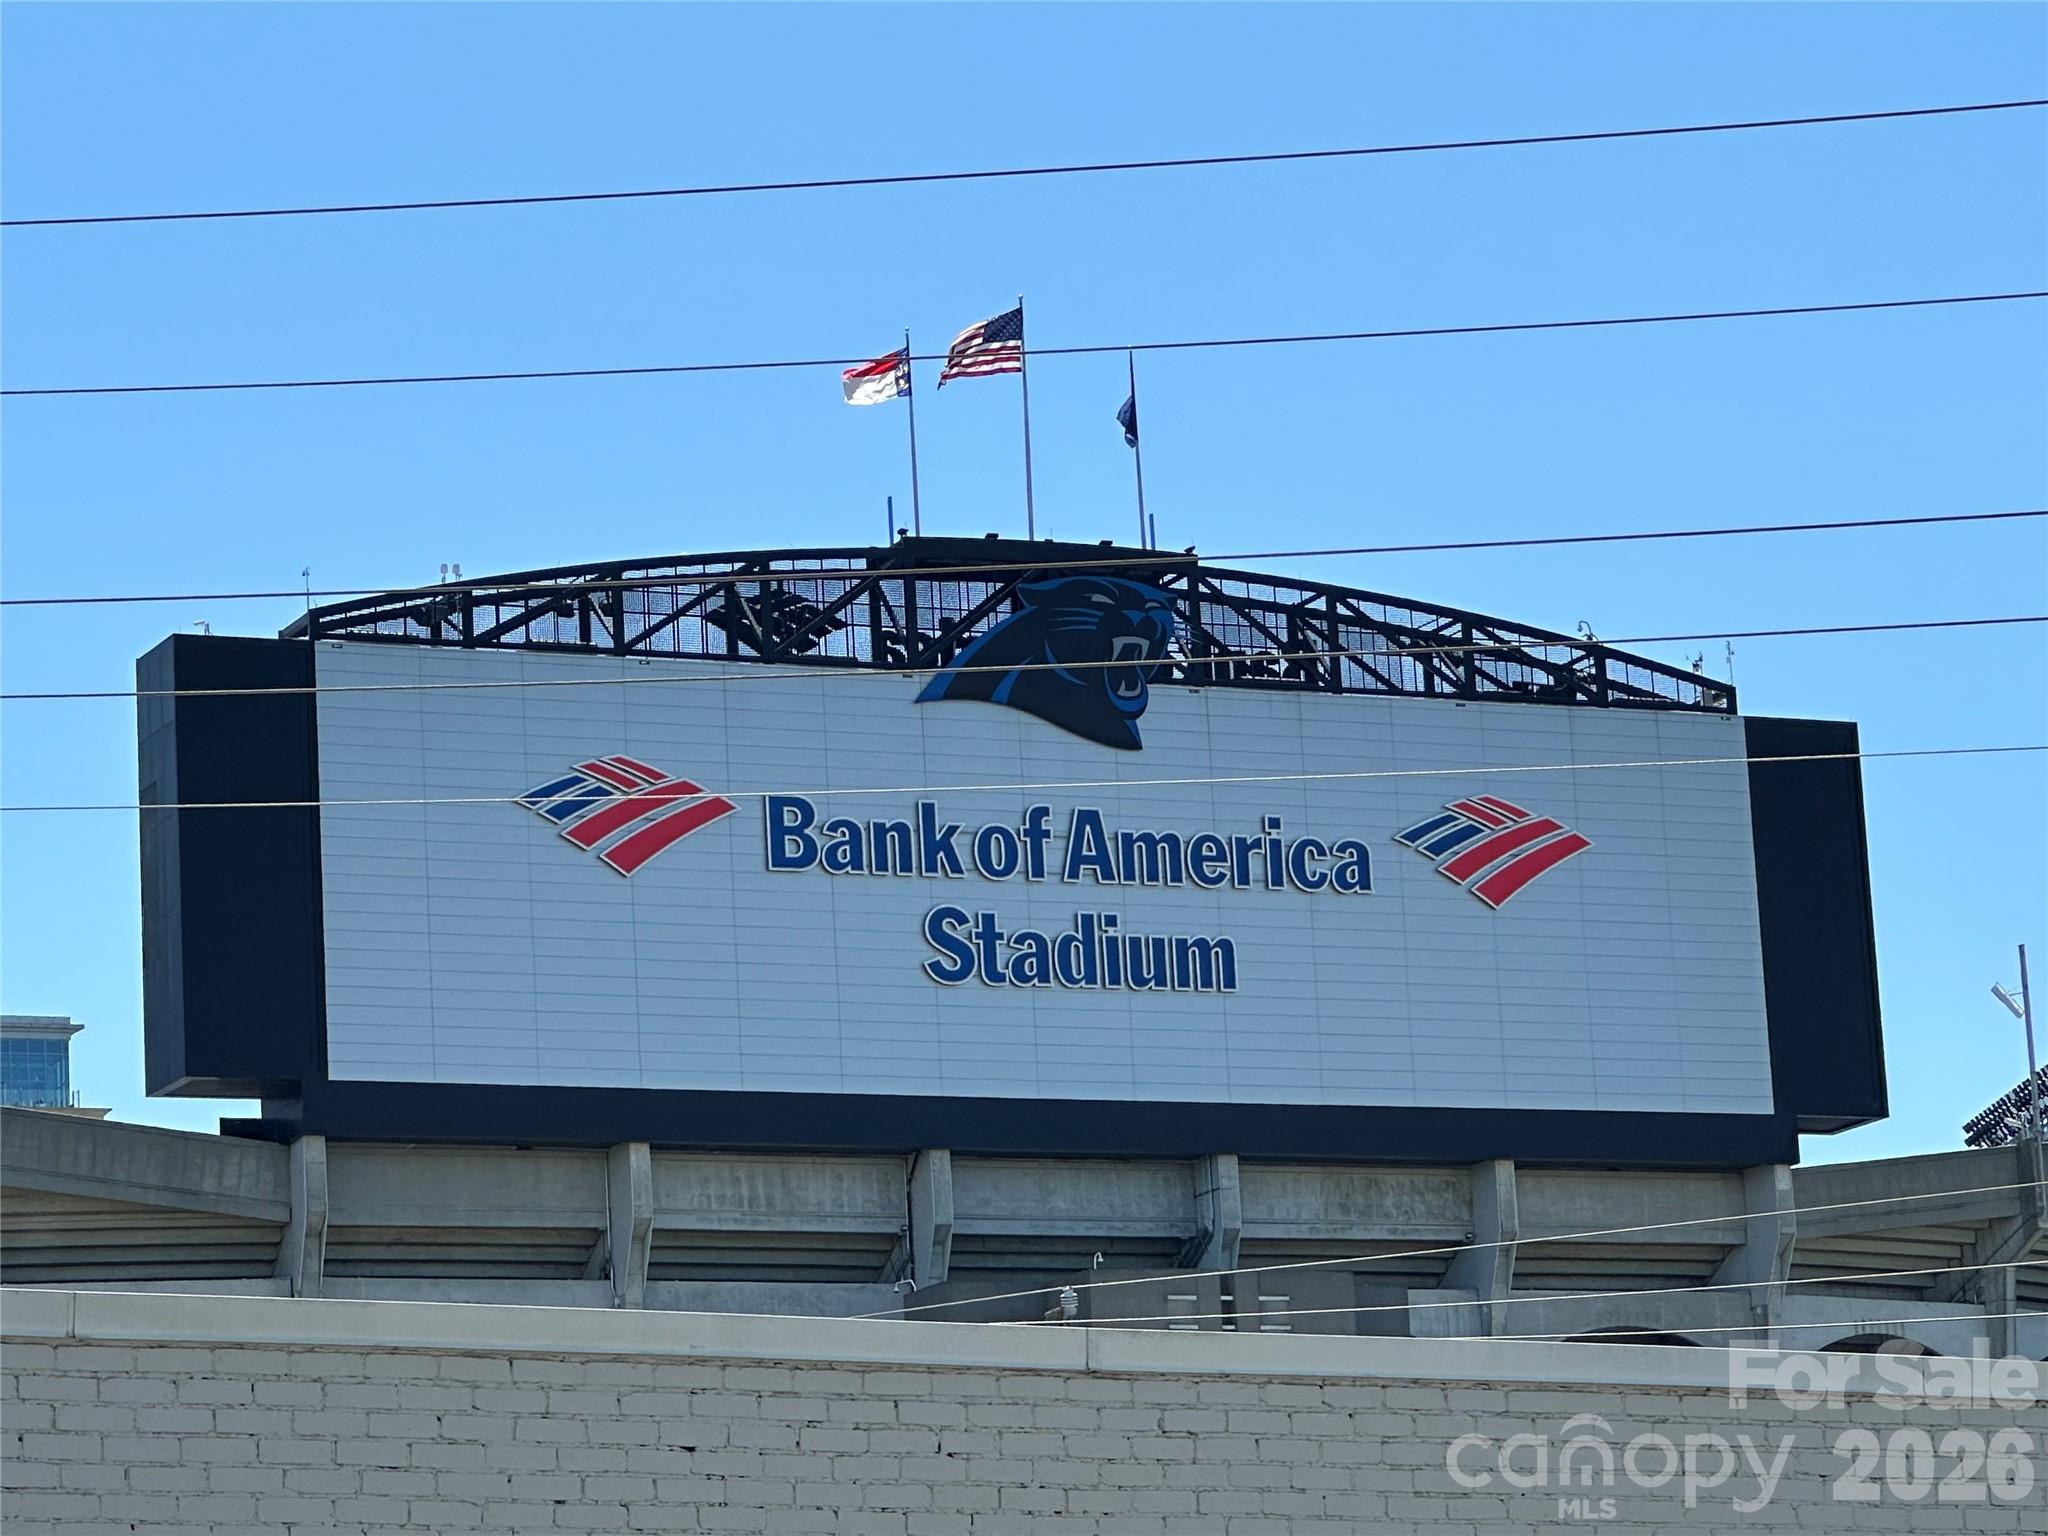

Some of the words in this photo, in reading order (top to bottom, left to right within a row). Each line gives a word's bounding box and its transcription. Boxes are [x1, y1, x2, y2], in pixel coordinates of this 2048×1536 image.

[764, 794, 966, 878] Bank
[973, 804, 1053, 882] of
[1063, 805, 1374, 894] America
[922, 902, 1239, 993] Stadium
